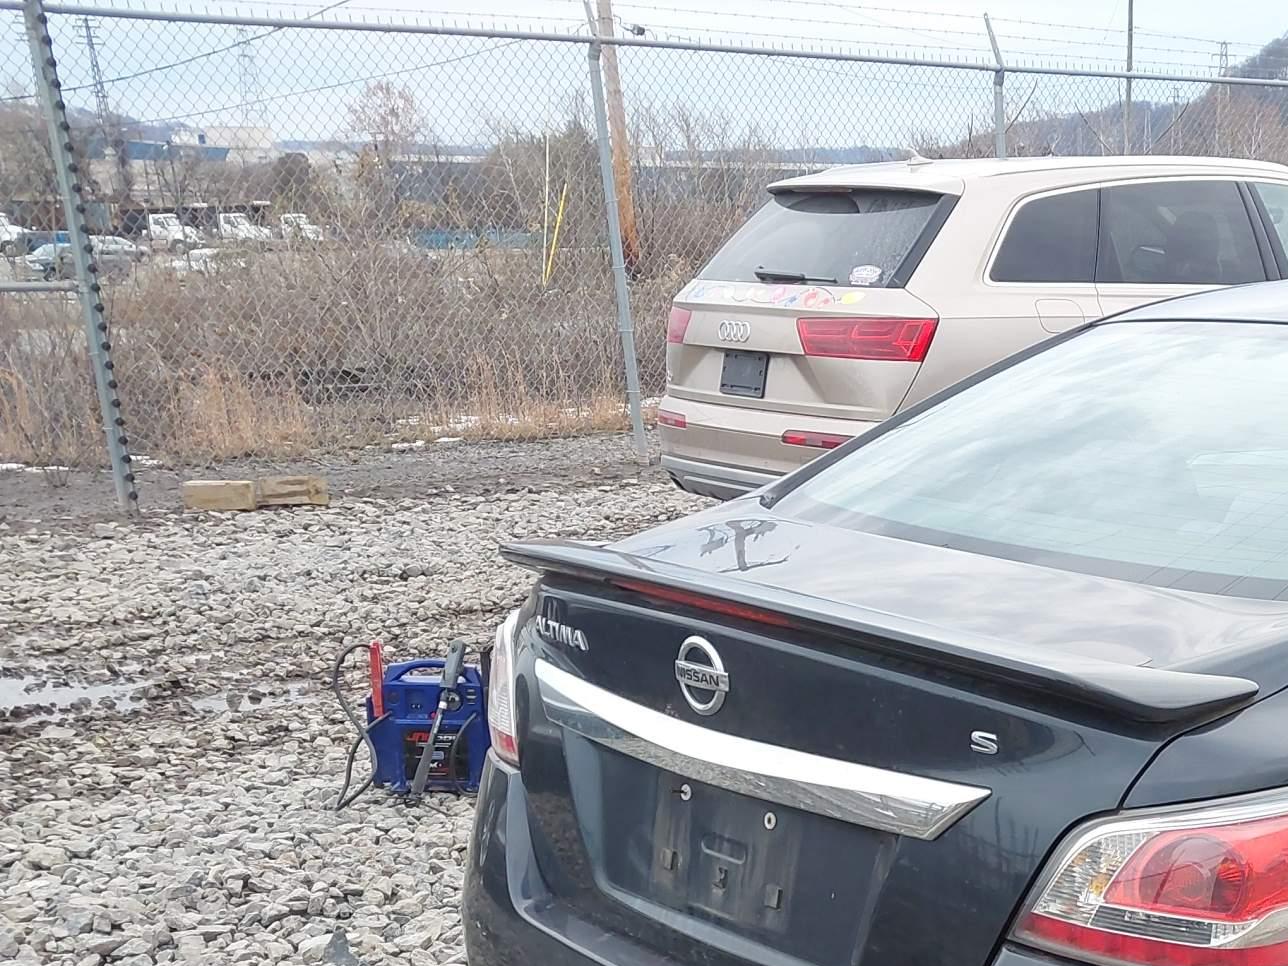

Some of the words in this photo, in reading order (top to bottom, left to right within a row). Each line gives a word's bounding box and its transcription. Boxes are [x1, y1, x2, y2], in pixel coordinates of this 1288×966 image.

[535, 614, 590, 651] ALTIMA
[678, 665, 720, 688] NISSAN
[970, 730, 998, 755] S
